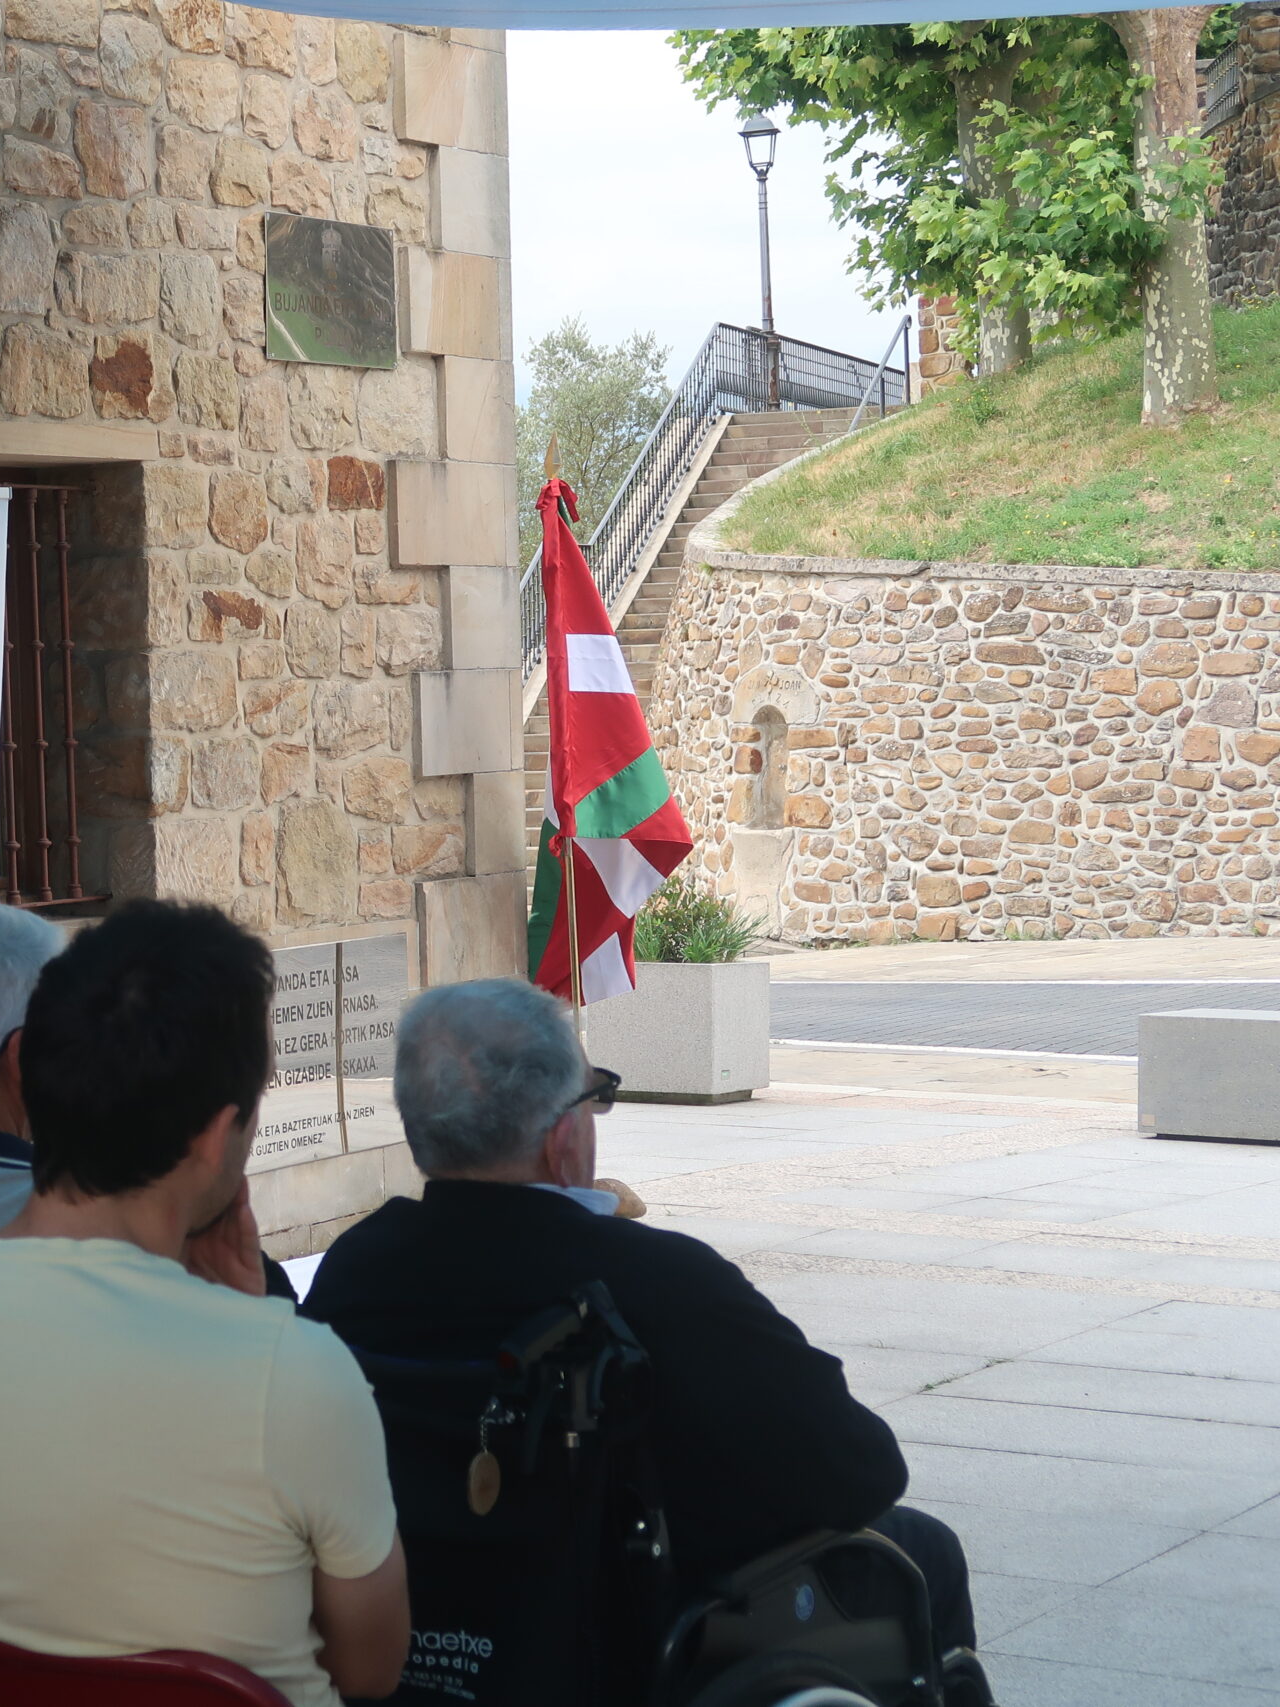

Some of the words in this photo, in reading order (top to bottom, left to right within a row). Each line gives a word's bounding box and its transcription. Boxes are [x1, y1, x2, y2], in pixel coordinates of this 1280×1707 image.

[309, 969, 329, 988] ETA
[306, 1000, 333, 1020] ZUEN
[340, 994, 378, 1014] RNASA.
[284, 1037, 297, 1054] EZ
[300, 1032, 328, 1052] GERA
[284, 1062, 331, 1086] GIZABIDE
[342, 1056, 378, 1076] SKAXA.
[265, 1124, 280, 1137] ETA
[282, 1113, 333, 1134] BAZTERTUAK
[353, 1106, 375, 1120] ZIREN
[256, 1140, 289, 1156] GUZTIEN
[410, 1653, 479, 1674] opedia
